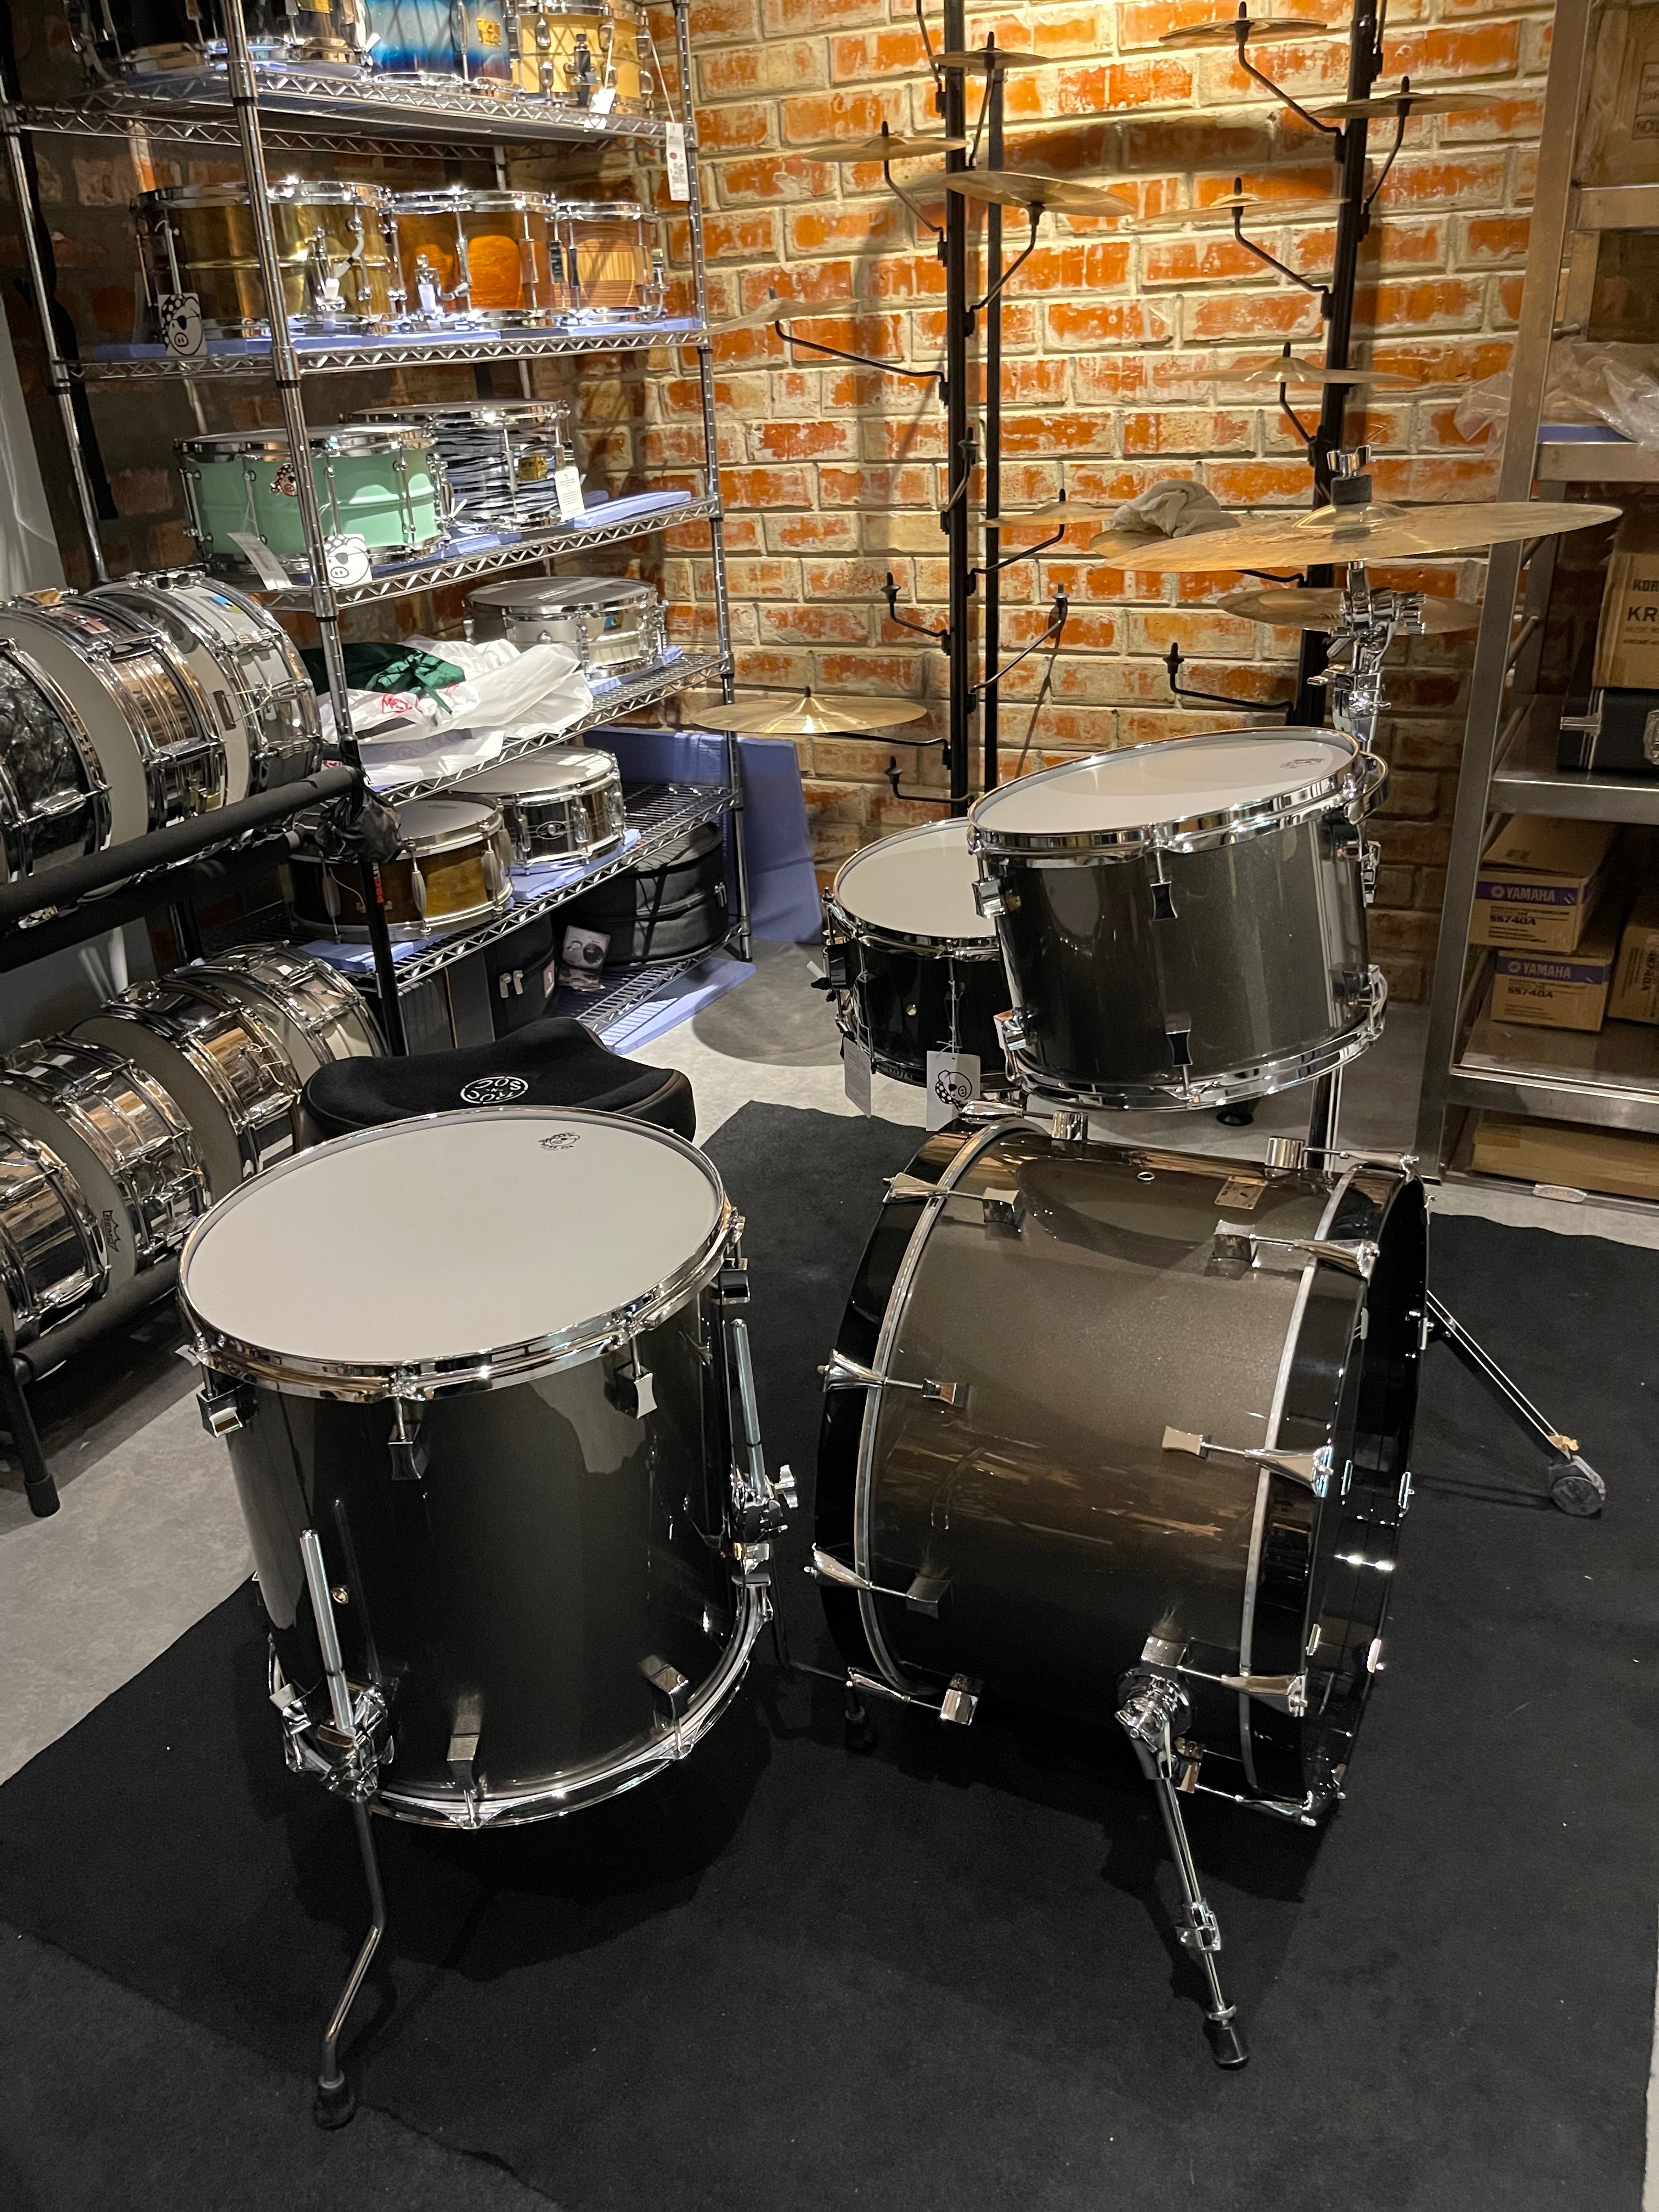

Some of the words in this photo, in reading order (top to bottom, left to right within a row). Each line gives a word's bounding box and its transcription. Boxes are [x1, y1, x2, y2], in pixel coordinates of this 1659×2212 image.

[1627, 606, 1659, 622] KR
[1507, 887, 1555, 902] YAMAHA
[1523, 962, 1572, 978] YAMAHA
[474, 1078, 521, 1091] SOC
[466, 1090, 514, 1102] ROC
